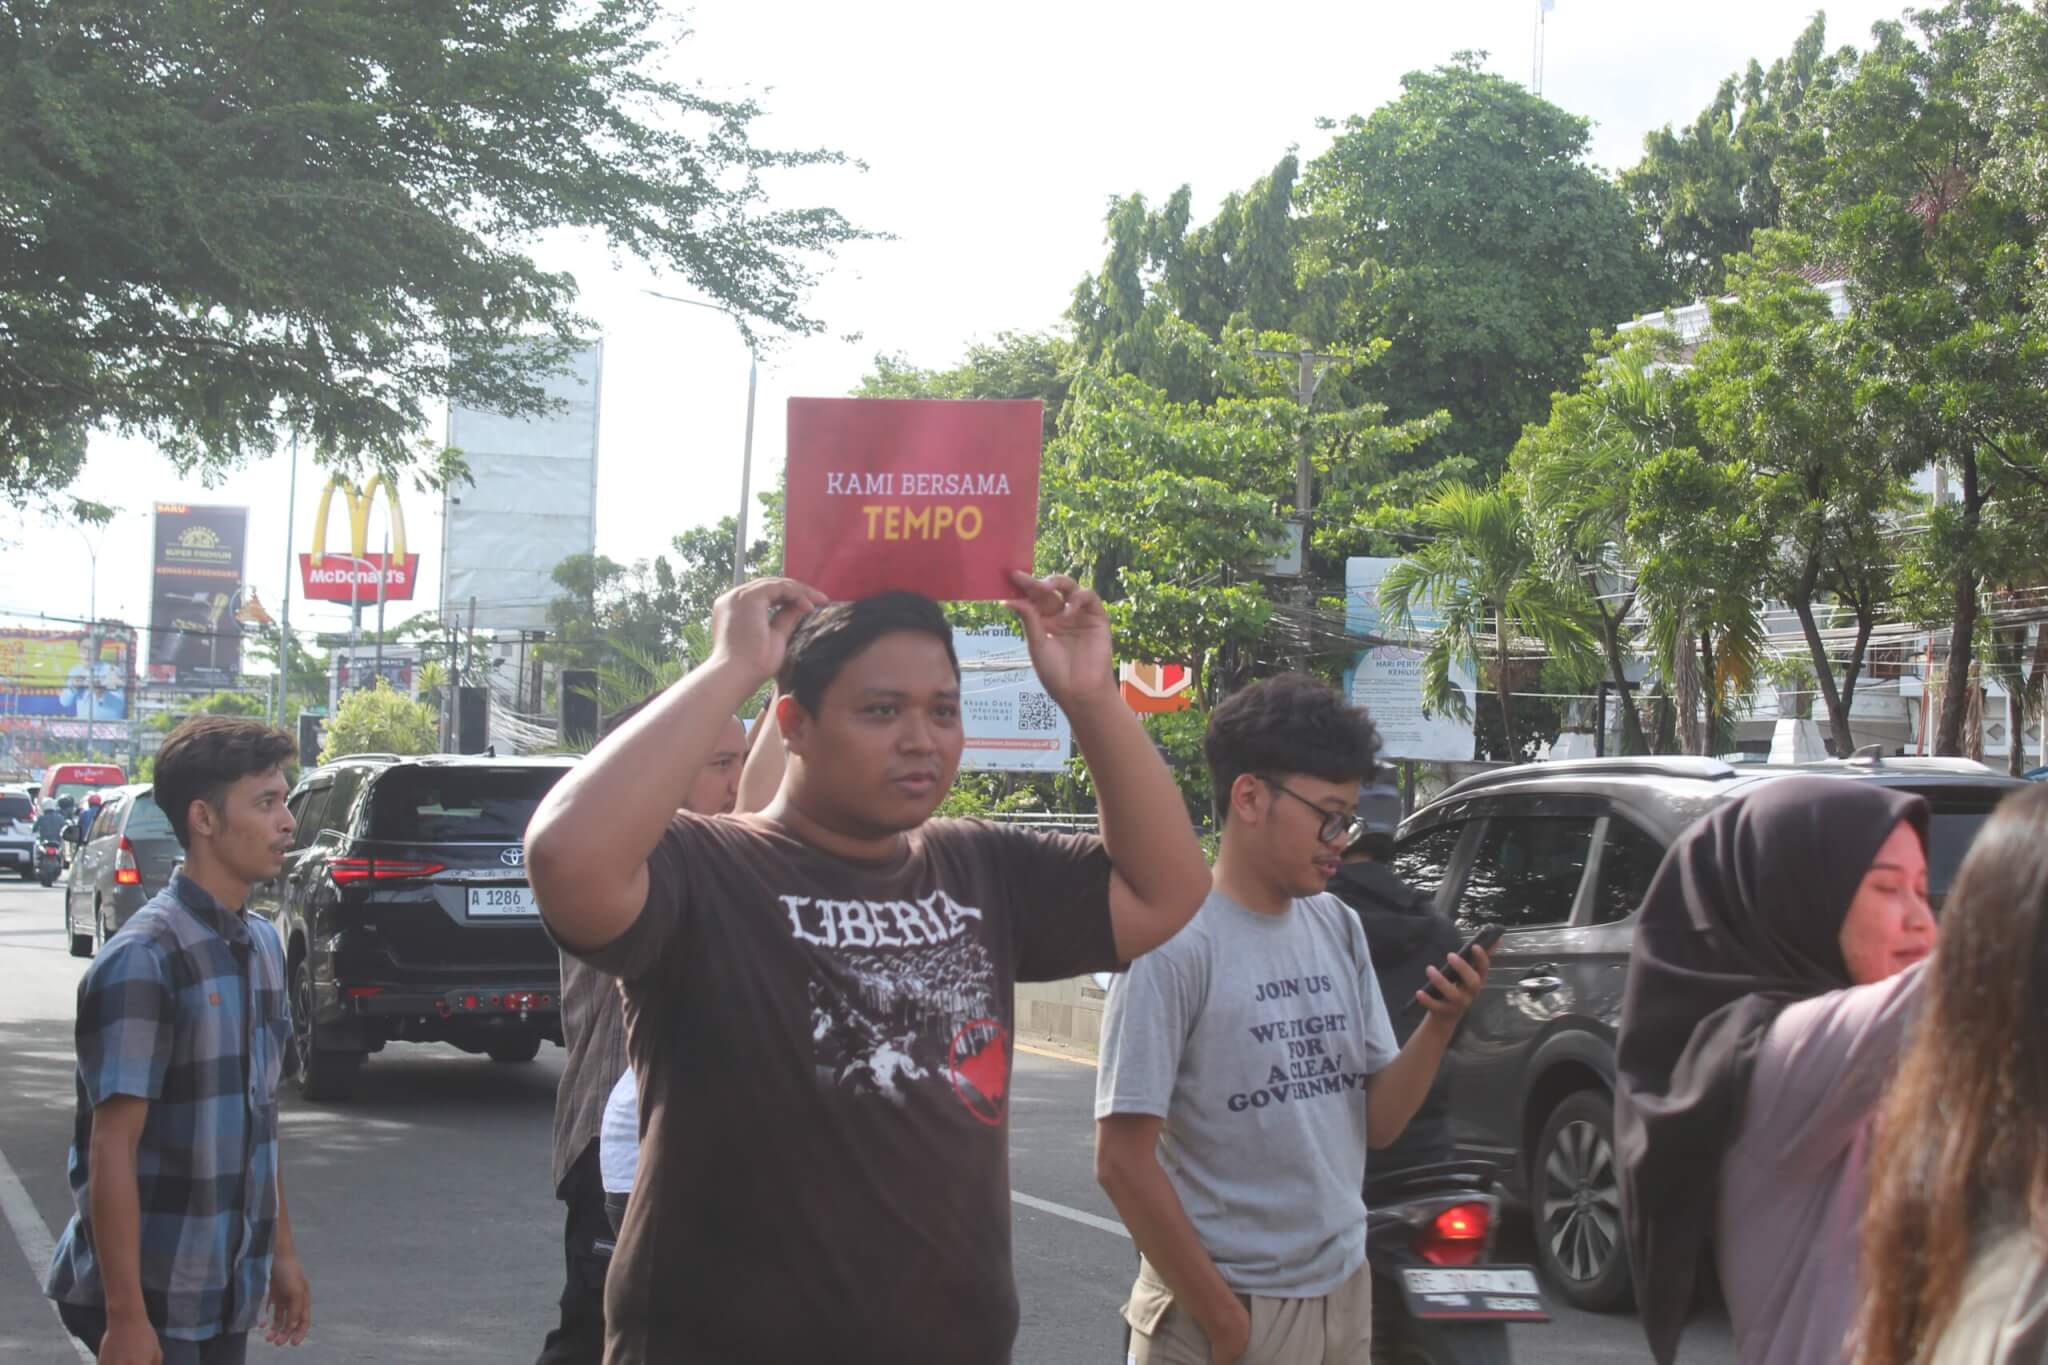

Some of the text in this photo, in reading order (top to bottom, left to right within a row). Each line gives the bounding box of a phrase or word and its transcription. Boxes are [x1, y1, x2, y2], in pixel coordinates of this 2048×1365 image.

[825, 472, 1011, 496] KAMI BERSAMA
[863, 505, 983, 541] TEMPO
[472, 890, 480, 906] A
[486, 890, 521, 906] 1286
[1255, 975, 1332, 1002] JOIN US
[1249, 1021, 1288, 1044] WE
[1287, 1038, 1325, 1060] FOR
[1267, 1064, 1289, 1085] A
